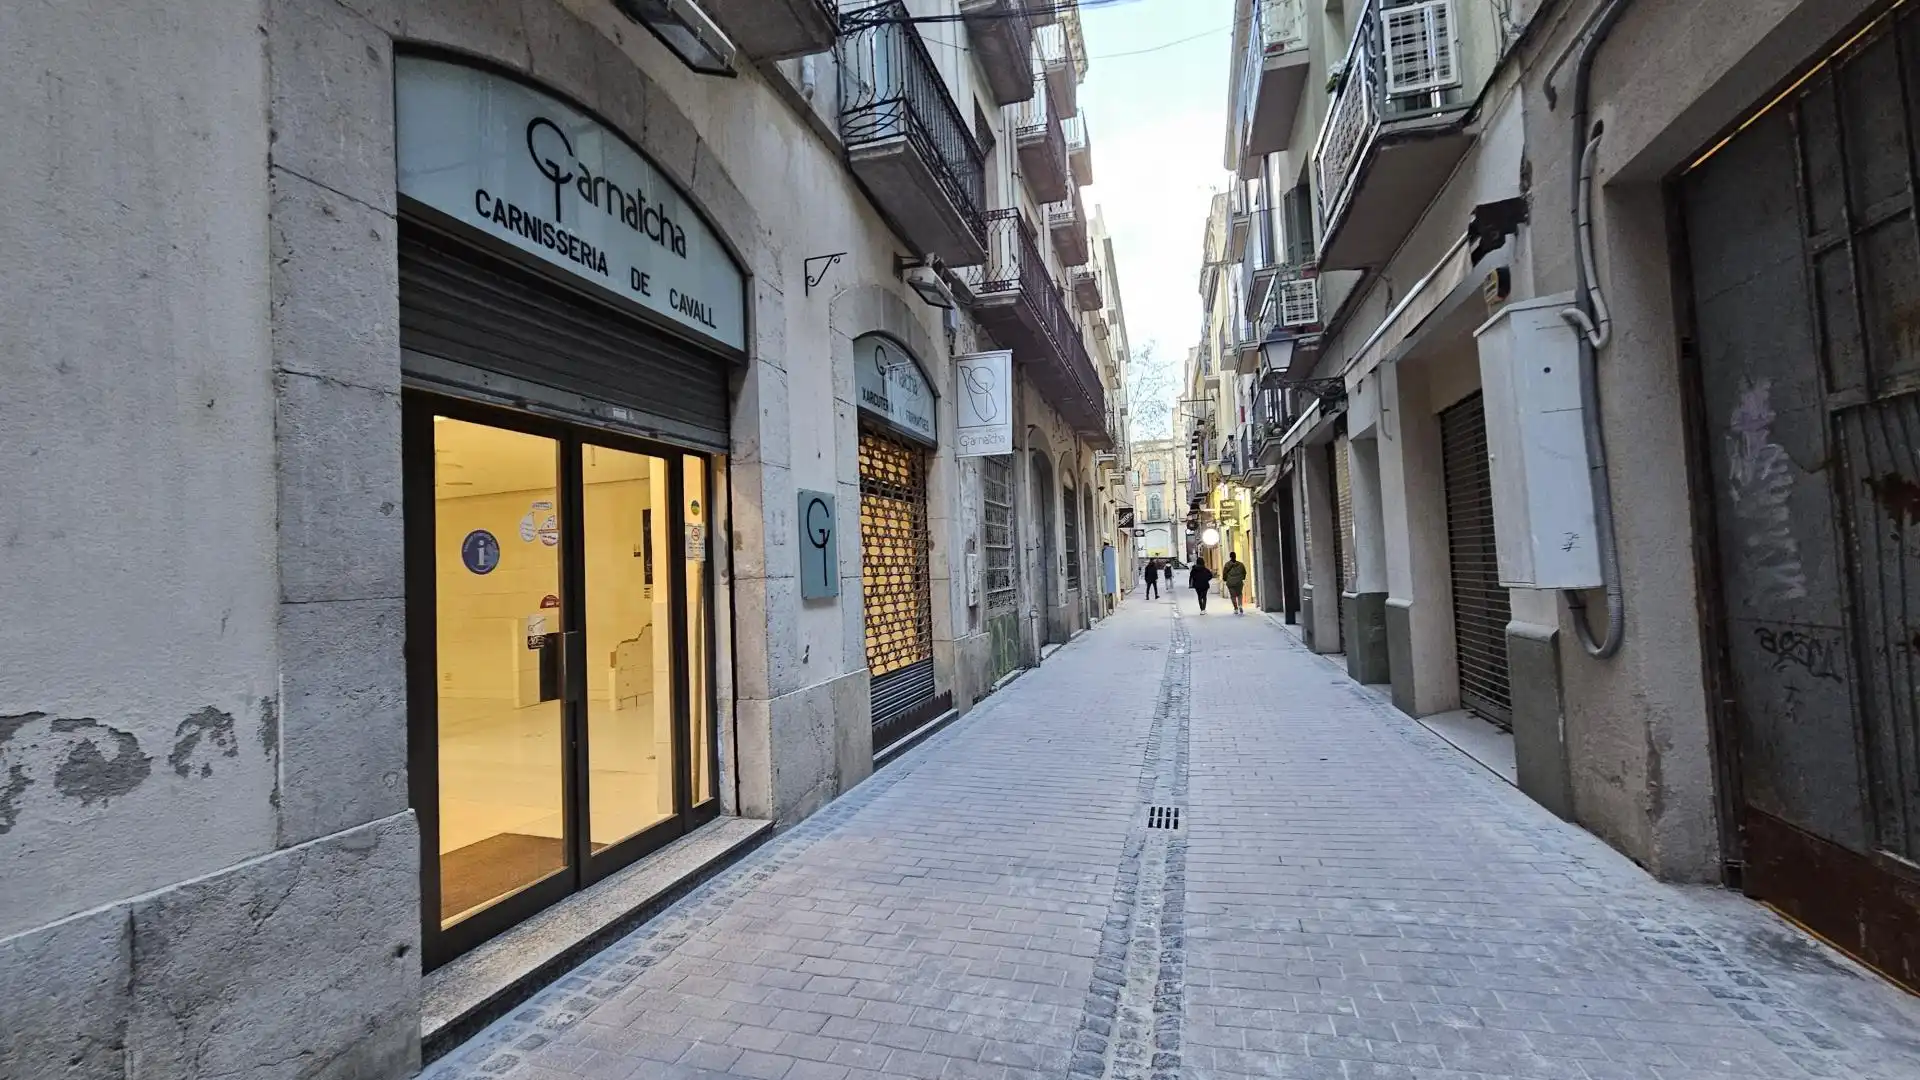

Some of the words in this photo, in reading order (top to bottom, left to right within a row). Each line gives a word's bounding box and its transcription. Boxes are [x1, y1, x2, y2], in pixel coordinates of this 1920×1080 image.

[475, 188, 609, 277] CARNISSERIA
[630, 265, 651, 297] DE
[669, 288, 717, 329] CAVALL
[526, 116, 687, 260] Garnatcha
